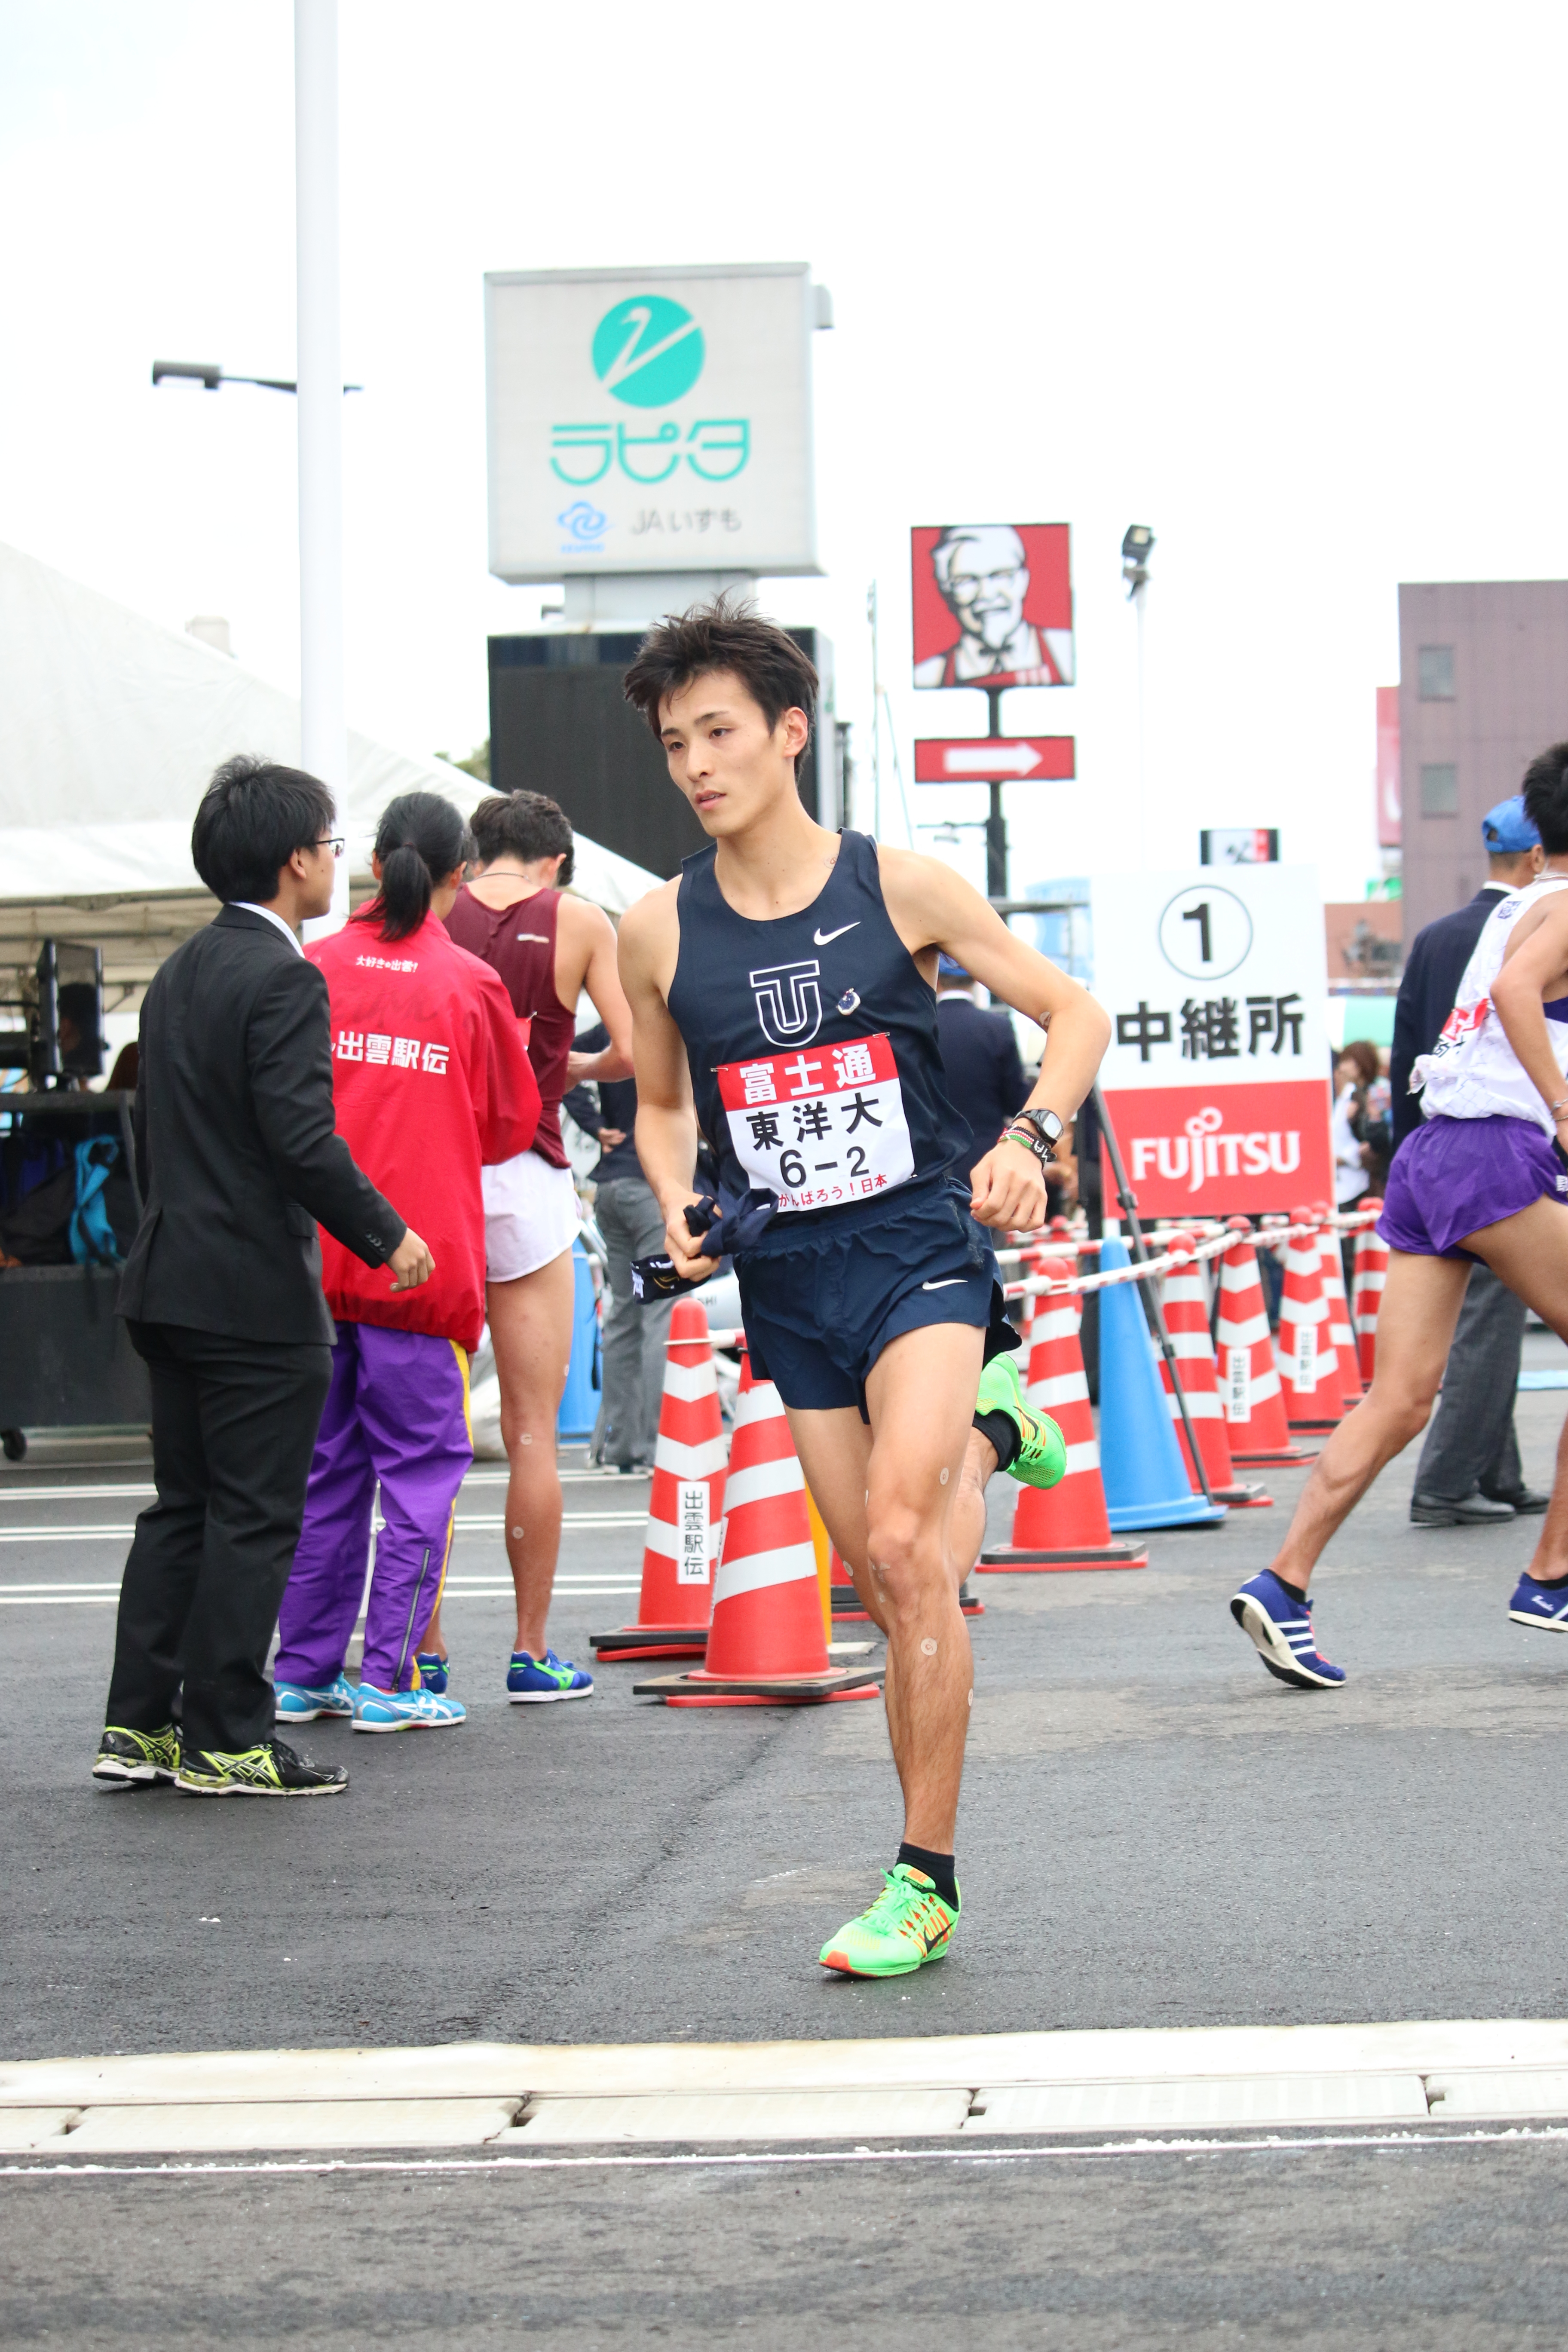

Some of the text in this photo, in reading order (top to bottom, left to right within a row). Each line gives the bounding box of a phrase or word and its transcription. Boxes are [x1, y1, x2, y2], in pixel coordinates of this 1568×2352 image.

[550, 419, 750, 486] ラピタ
[1116, 994, 1304, 1062] 中継所
[740, 1043, 876, 1104] 富士通
[746, 1092, 883, 1151] 東洋大
[1131, 1130, 1300, 1192] FUJITSU
[684, 1490, 704, 1576] 出雲駅伝
